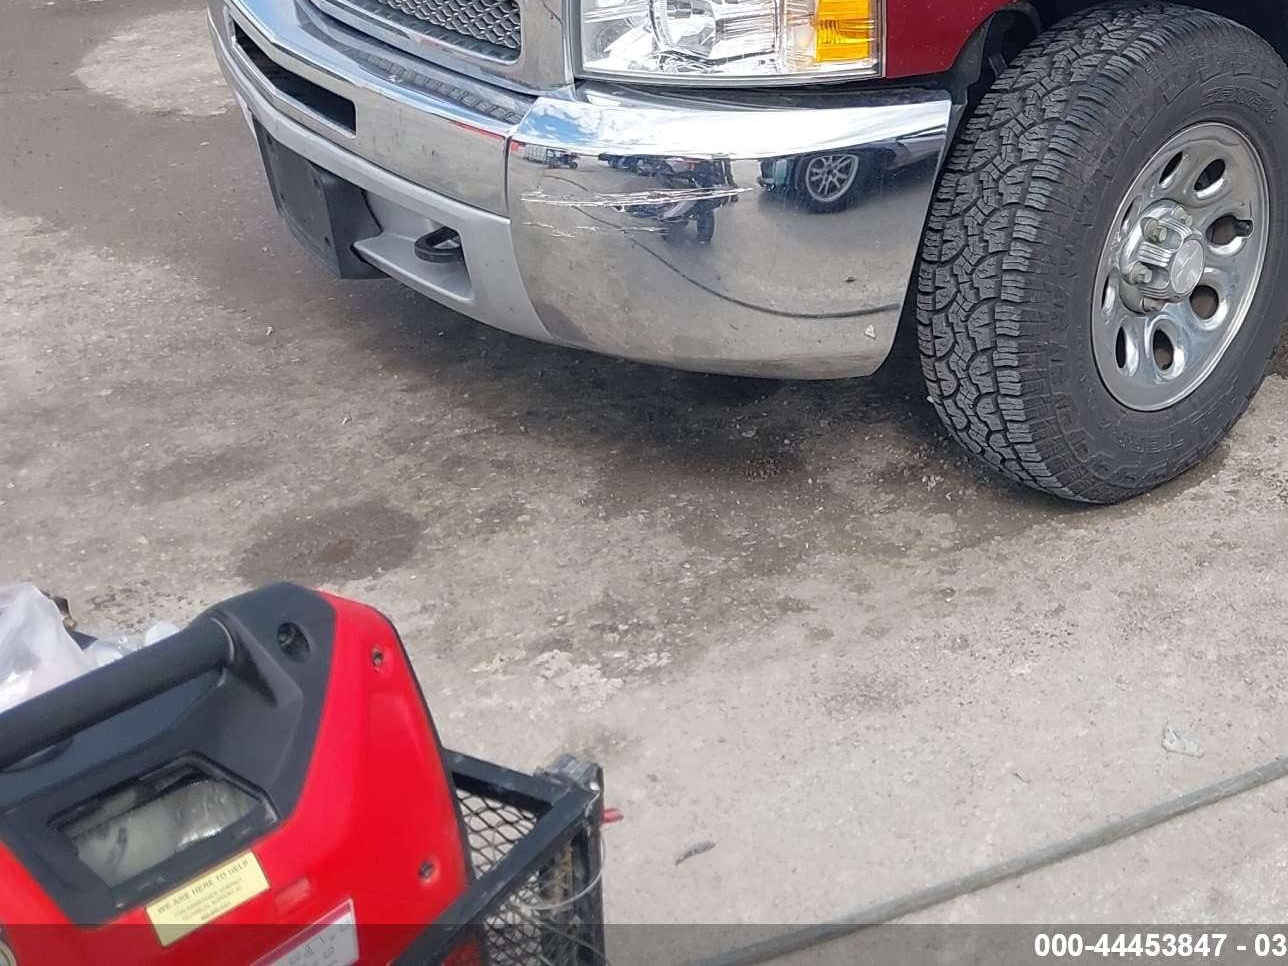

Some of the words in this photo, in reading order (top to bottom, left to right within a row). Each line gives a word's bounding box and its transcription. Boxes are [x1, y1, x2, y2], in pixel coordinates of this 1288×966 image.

[157, 903, 172, 915] WE
[173, 891, 190, 906] ARE
[191, 878, 214, 896] HERE
[215, 871, 228, 883] TO
